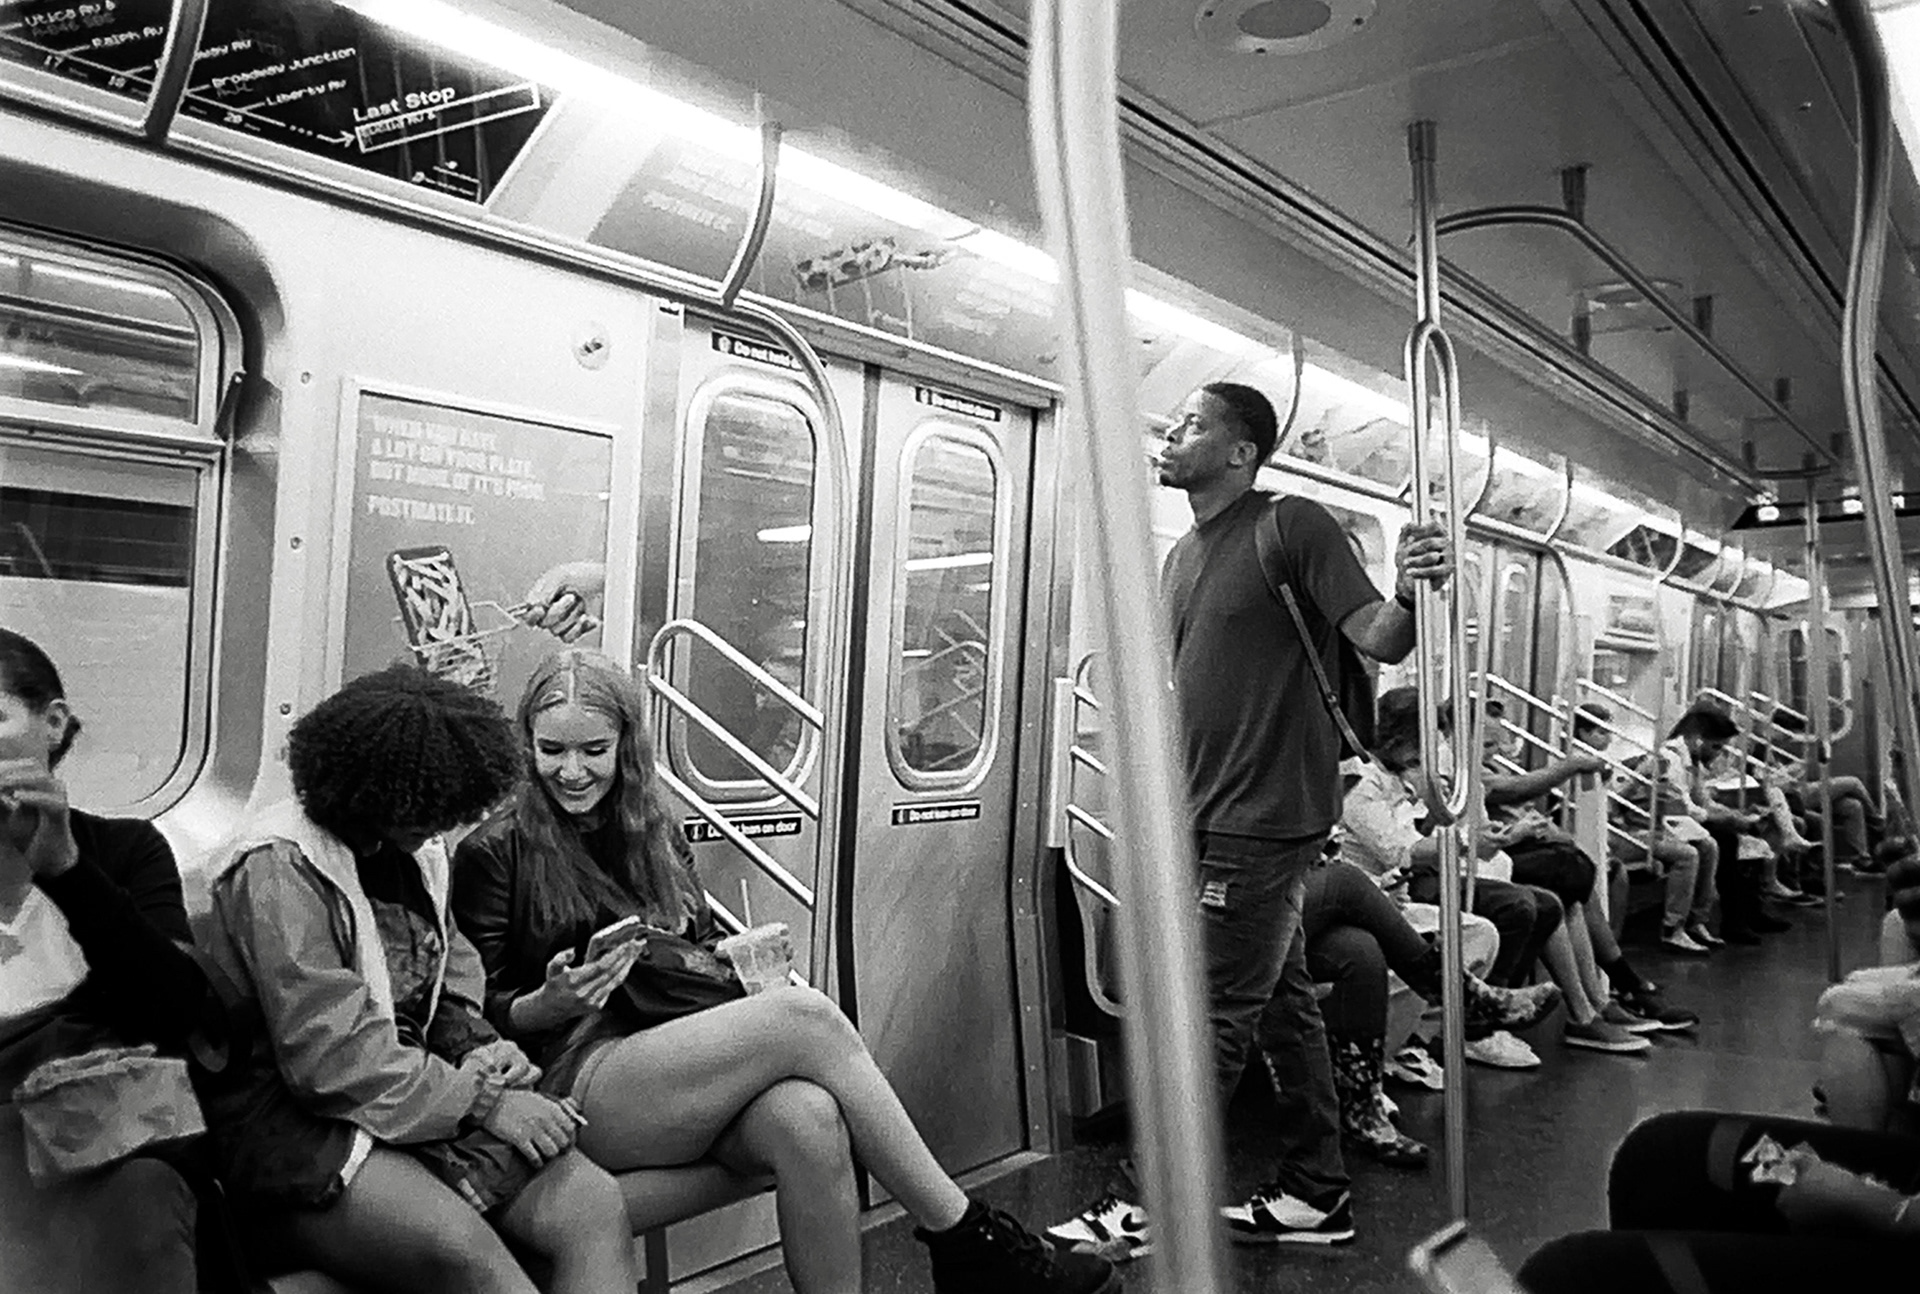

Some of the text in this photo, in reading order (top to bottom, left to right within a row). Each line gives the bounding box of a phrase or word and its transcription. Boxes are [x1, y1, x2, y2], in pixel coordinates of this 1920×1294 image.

[25, 9, 76, 27] Utica
[92, 31, 140, 48] Ralph
[211, 47, 356, 88] Broadway Junction
[266, 84, 325, 106] Liberty
[353, 87, 455, 122] Last Stop
[734, 340, 751, 357] Do
[762, 823, 775, 834] on
[775, 820, 797, 834] door
